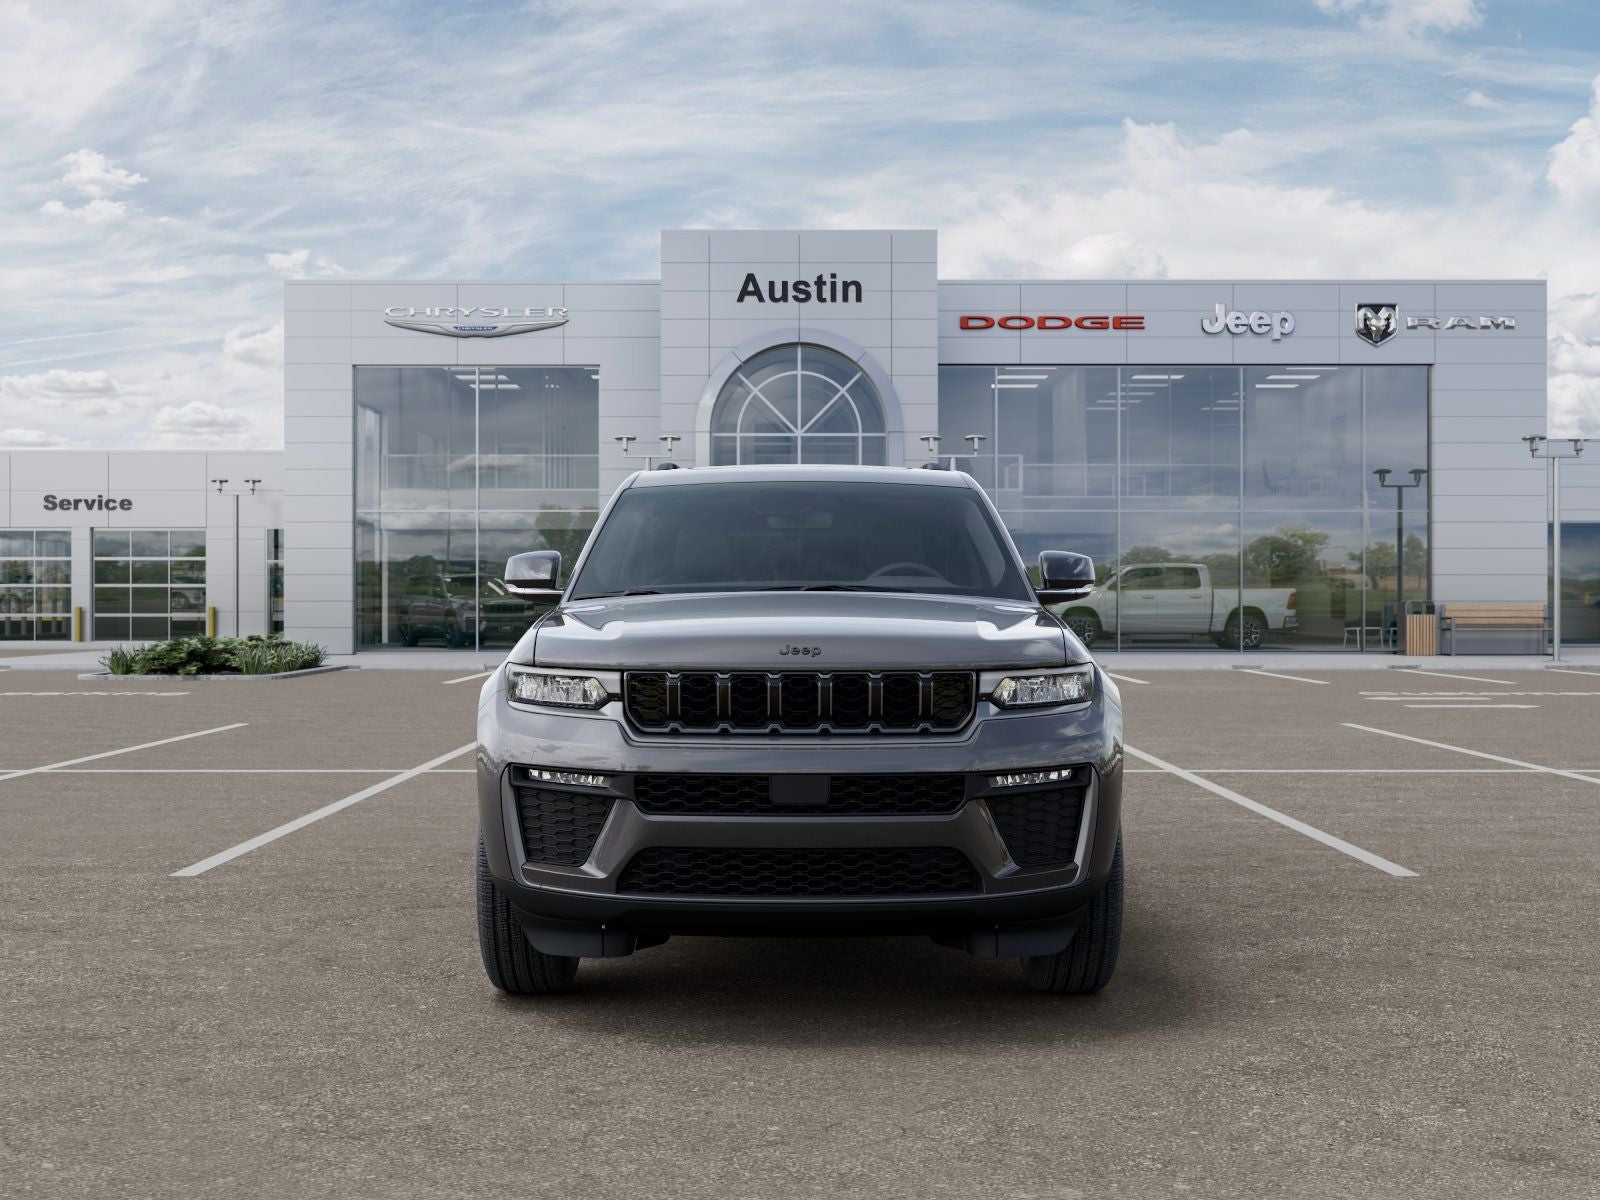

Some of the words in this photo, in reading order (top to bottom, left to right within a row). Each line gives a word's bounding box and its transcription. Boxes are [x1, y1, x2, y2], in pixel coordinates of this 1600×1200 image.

[737, 272, 863, 303] Austin
[385, 306, 570, 317] CHRYSLER
[959, 315, 1146, 330] DODGE
[1201, 302, 1295, 341] Jeep
[1406, 316, 1515, 330] RAM
[43, 494, 133, 511] Service
[779, 644, 822, 658] Jeep
